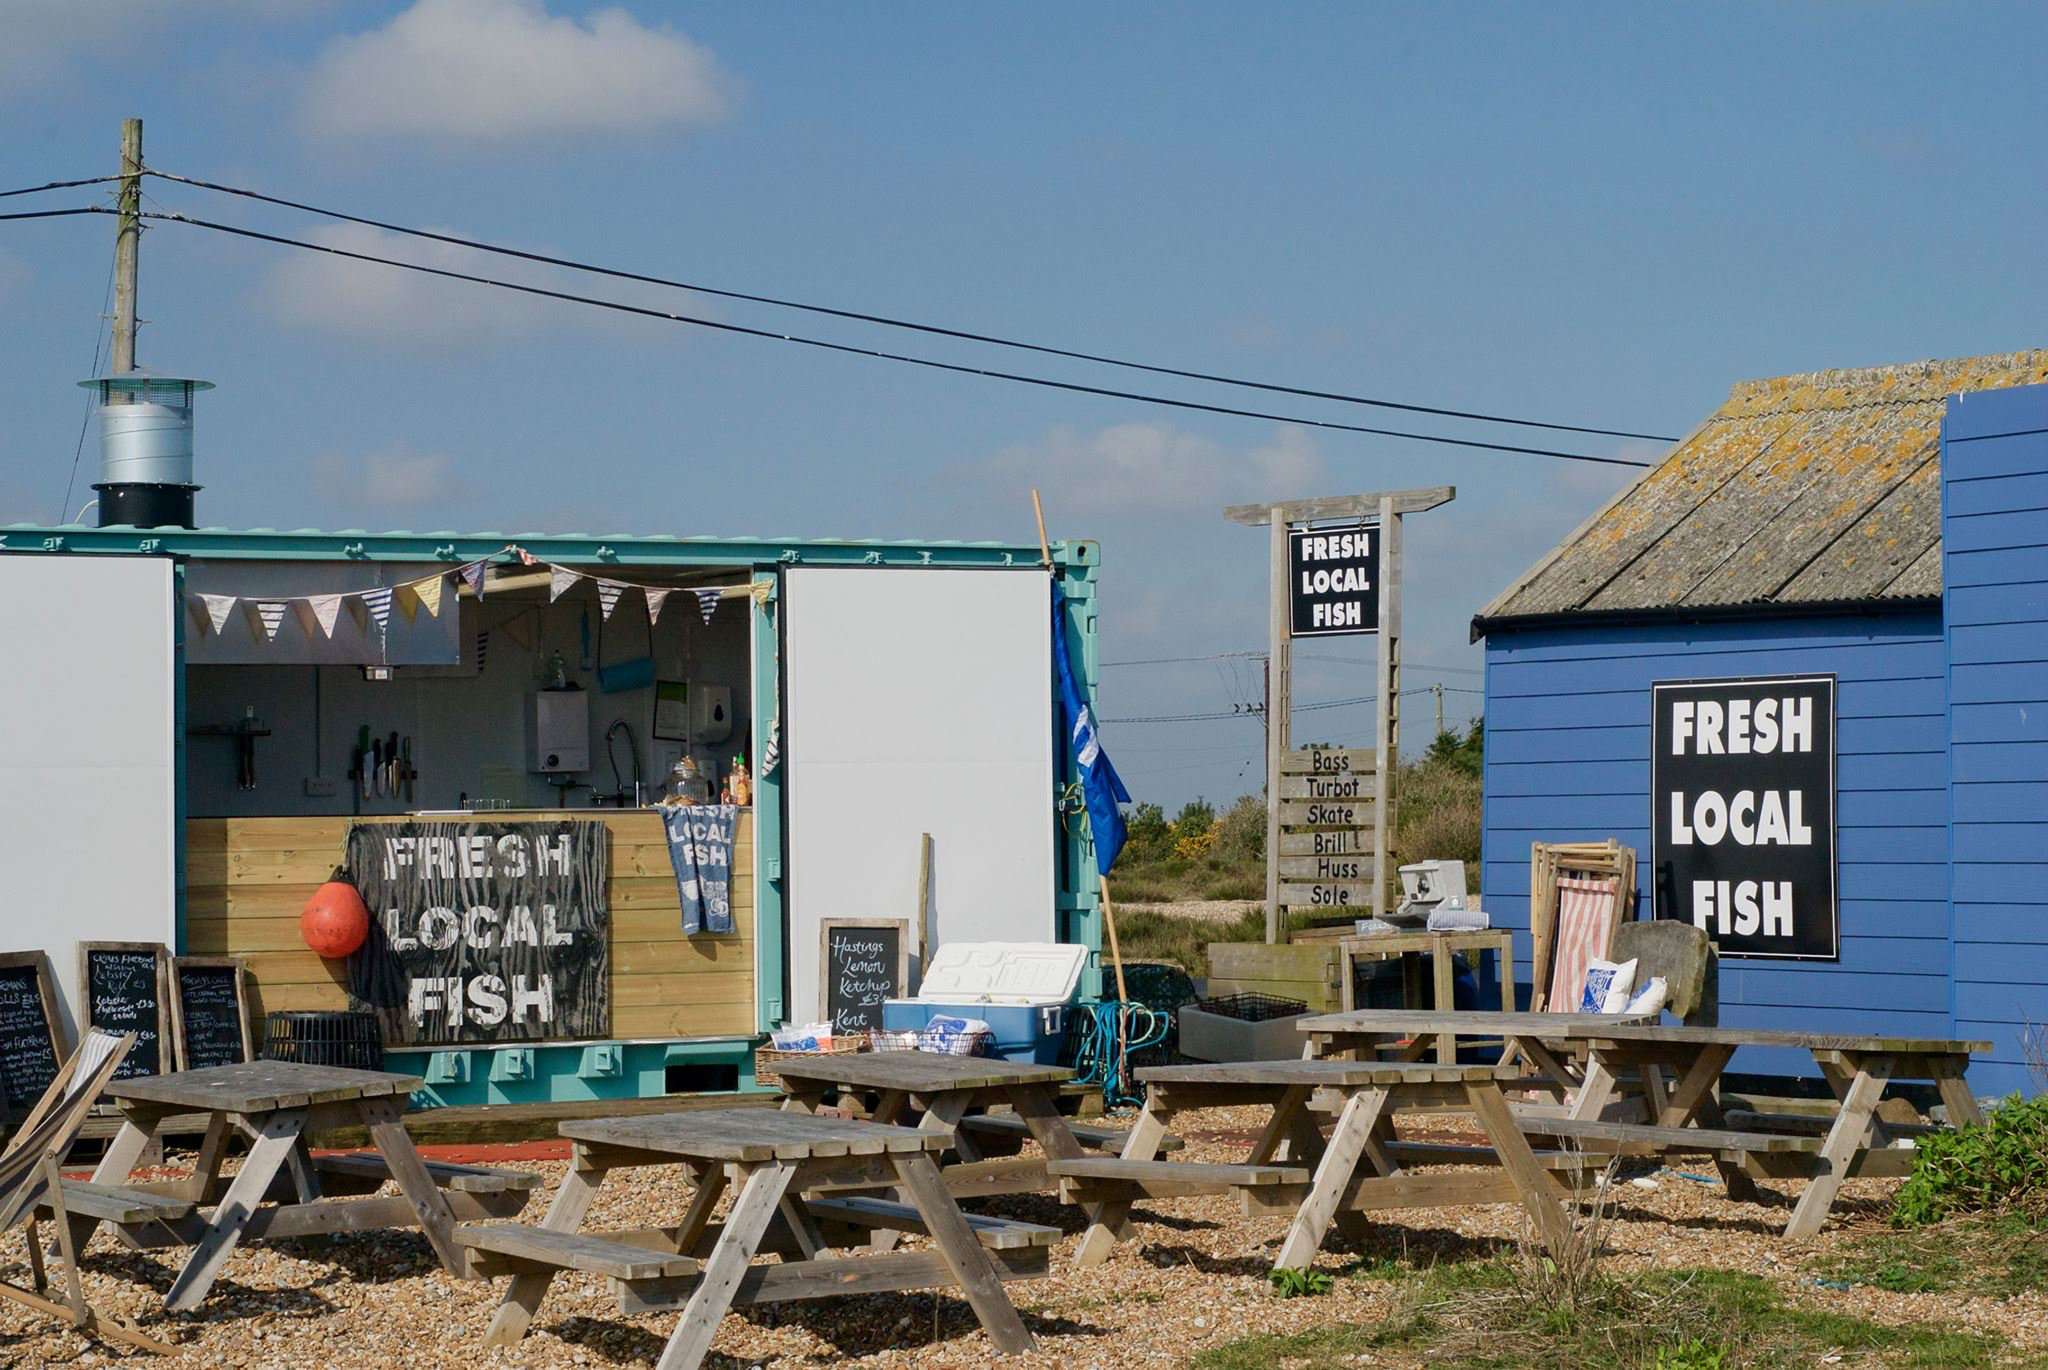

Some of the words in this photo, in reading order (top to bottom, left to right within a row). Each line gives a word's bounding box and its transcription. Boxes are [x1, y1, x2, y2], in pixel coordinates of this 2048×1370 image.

[1302, 533, 1369, 561] FRESH
[1302, 567, 1370, 595] LOCAL
[1313, 601, 1361, 627] FISH
[1672, 697, 1812, 755] FRESH
[1312, 750, 1349, 771] Bass
[1306, 776, 1359, 797] Turbot
[1307, 804, 1353, 824] Skate
[1671, 790, 1812, 846] LOCAL
[1314, 831, 1347, 853] Brill
[384, 834, 571, 880] FRESH
[682, 843, 728, 867] FSH
[1318, 858, 1358, 878] Huss
[1311, 885, 1348, 905] Sole
[1692, 880, 1794, 936] FISH
[386, 904, 573, 953] LOCAL
[833, 936, 884, 964] Hastings
[842, 956, 886, 978] Lemon
[840, 977, 891, 998] Ketchup
[408, 974, 553, 1028] FISH
[835, 1008, 868, 1032] Kent
